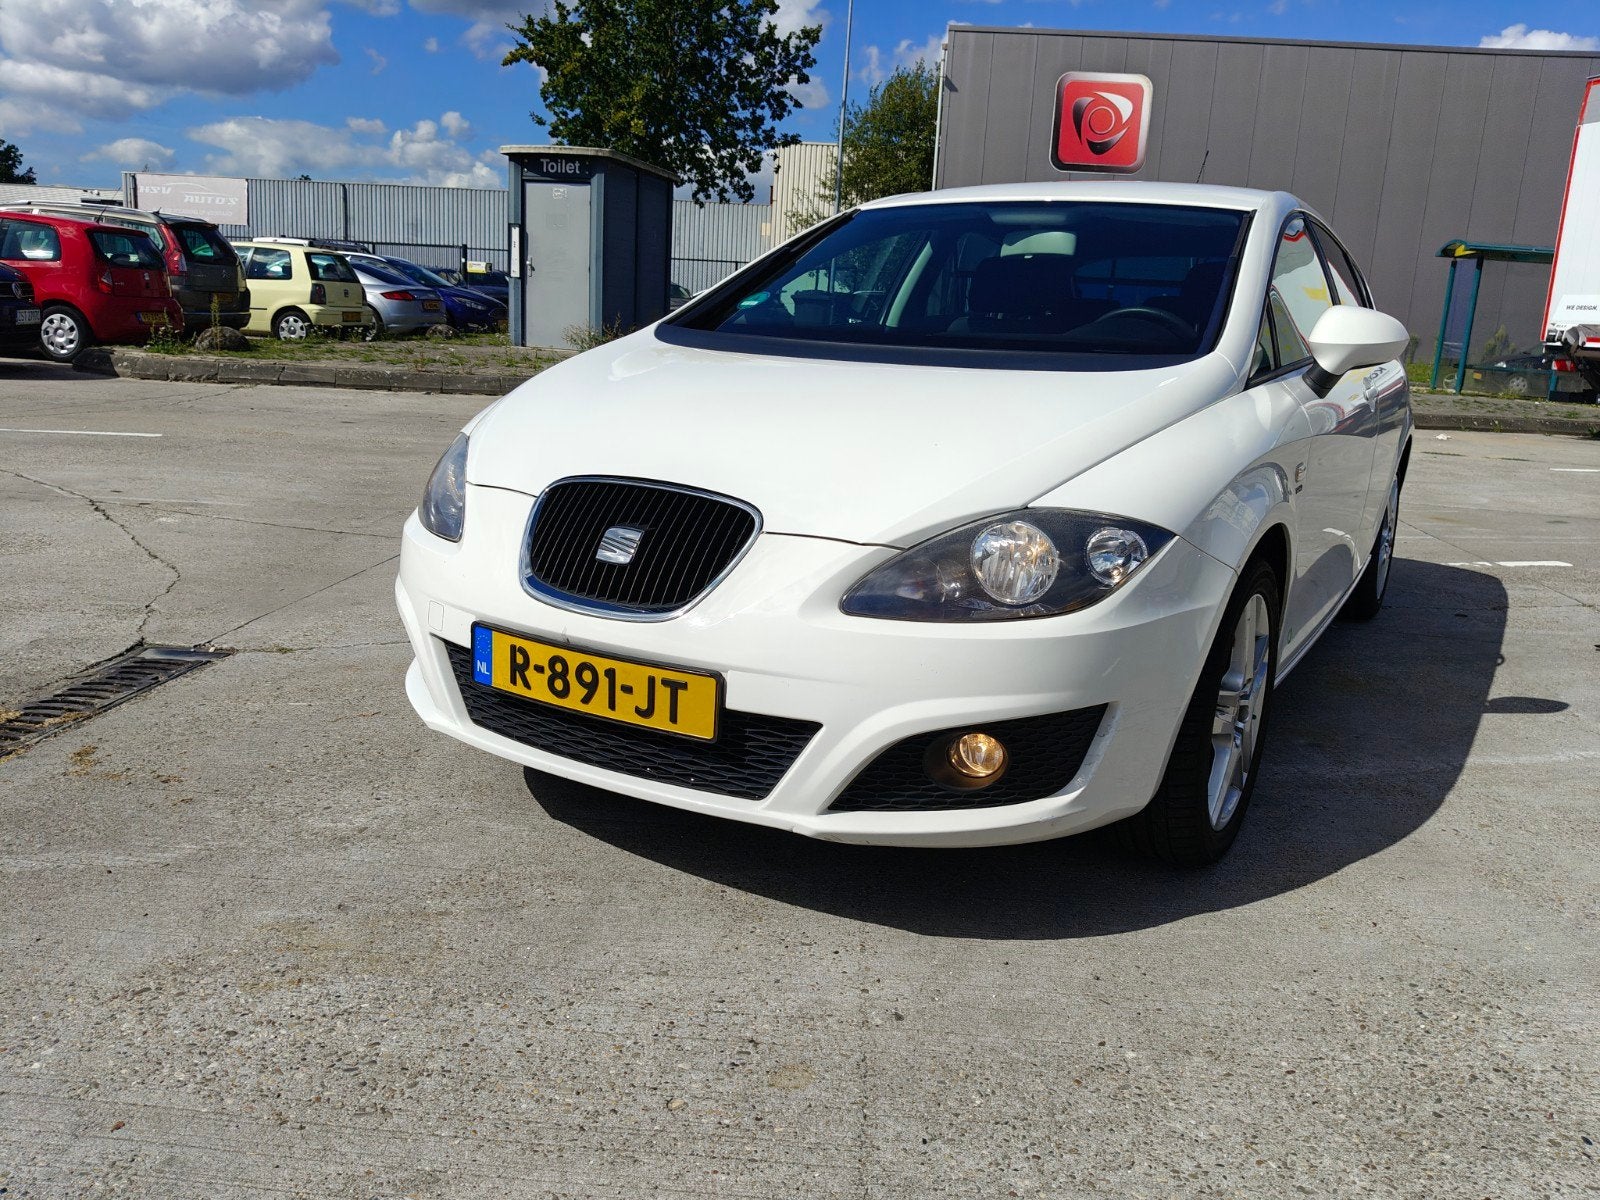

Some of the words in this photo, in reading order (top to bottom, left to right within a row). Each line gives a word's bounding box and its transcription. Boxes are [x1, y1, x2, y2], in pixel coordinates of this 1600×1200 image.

[540, 158, 580, 174] Toilet
[139, 184, 172, 194] HSV
[477, 659, 490, 675] NL
[509, 643, 688, 725] R-891-JT
